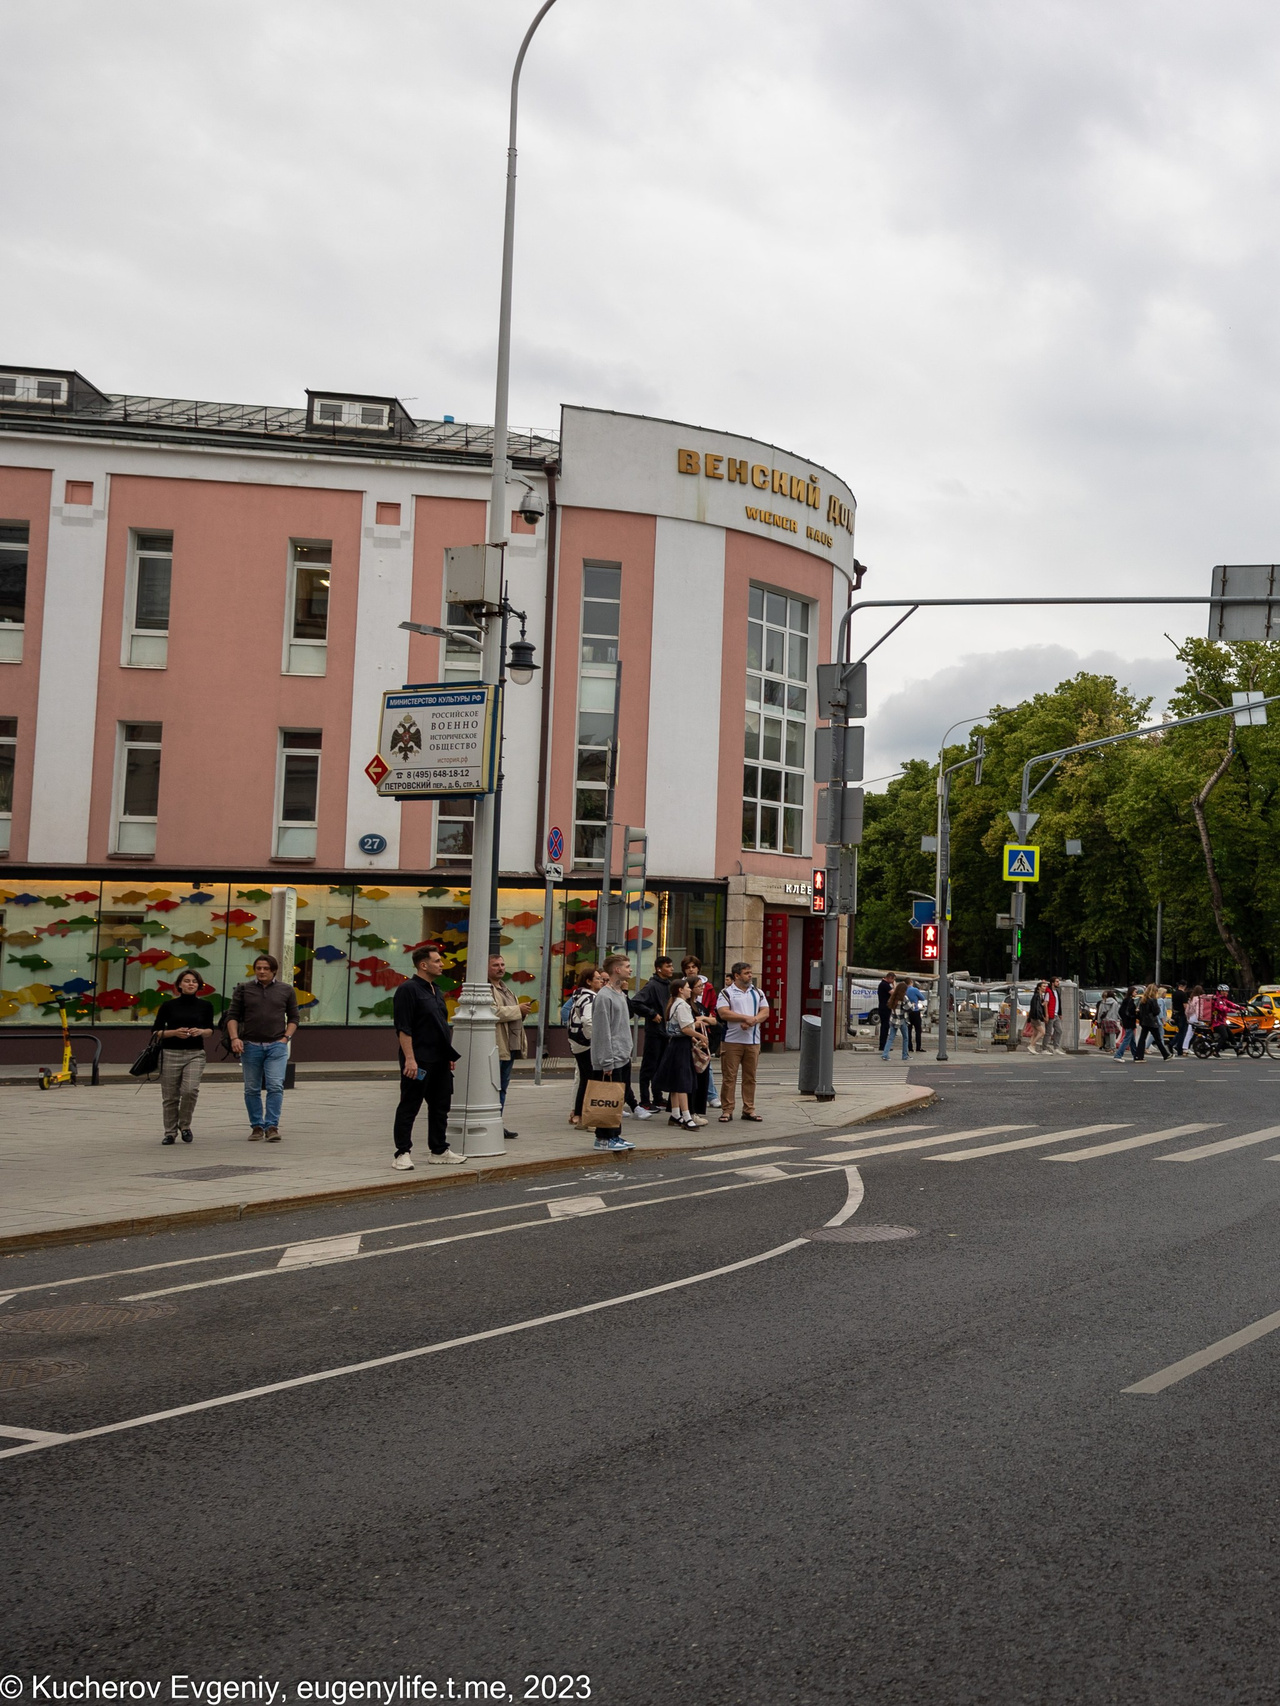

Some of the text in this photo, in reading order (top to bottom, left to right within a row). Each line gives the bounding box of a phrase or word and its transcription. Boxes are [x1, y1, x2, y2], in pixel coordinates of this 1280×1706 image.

[678, 448, 854, 535] ВЕНСКИЙ ДОМ
[745, 505, 833, 548] WIENER HAUS
[389, 694, 482, 707] МИНИСТЕРСТВО КУЛЬТУРЫ РФ
[431, 710, 479, 719] РОССИЙСКОЕ
[431, 720, 479, 730] ВОЕННО
[430, 732, 478, 741] ИСТОРИЧЕСКОЕ
[429, 742, 477, 752] ОБЩЕСТВО
[406, 769, 470, 780] 8 (495) 648-18-12
[384, 779, 431, 790] ПЕТРОВСКИЙ
[475, 779, 481, 787] 1
[364, 838, 380, 849] 27
[813, 895, 824, 910] 34
[924, 945, 937, 957] 34
[590, 1099, 619, 1108] ECRU
